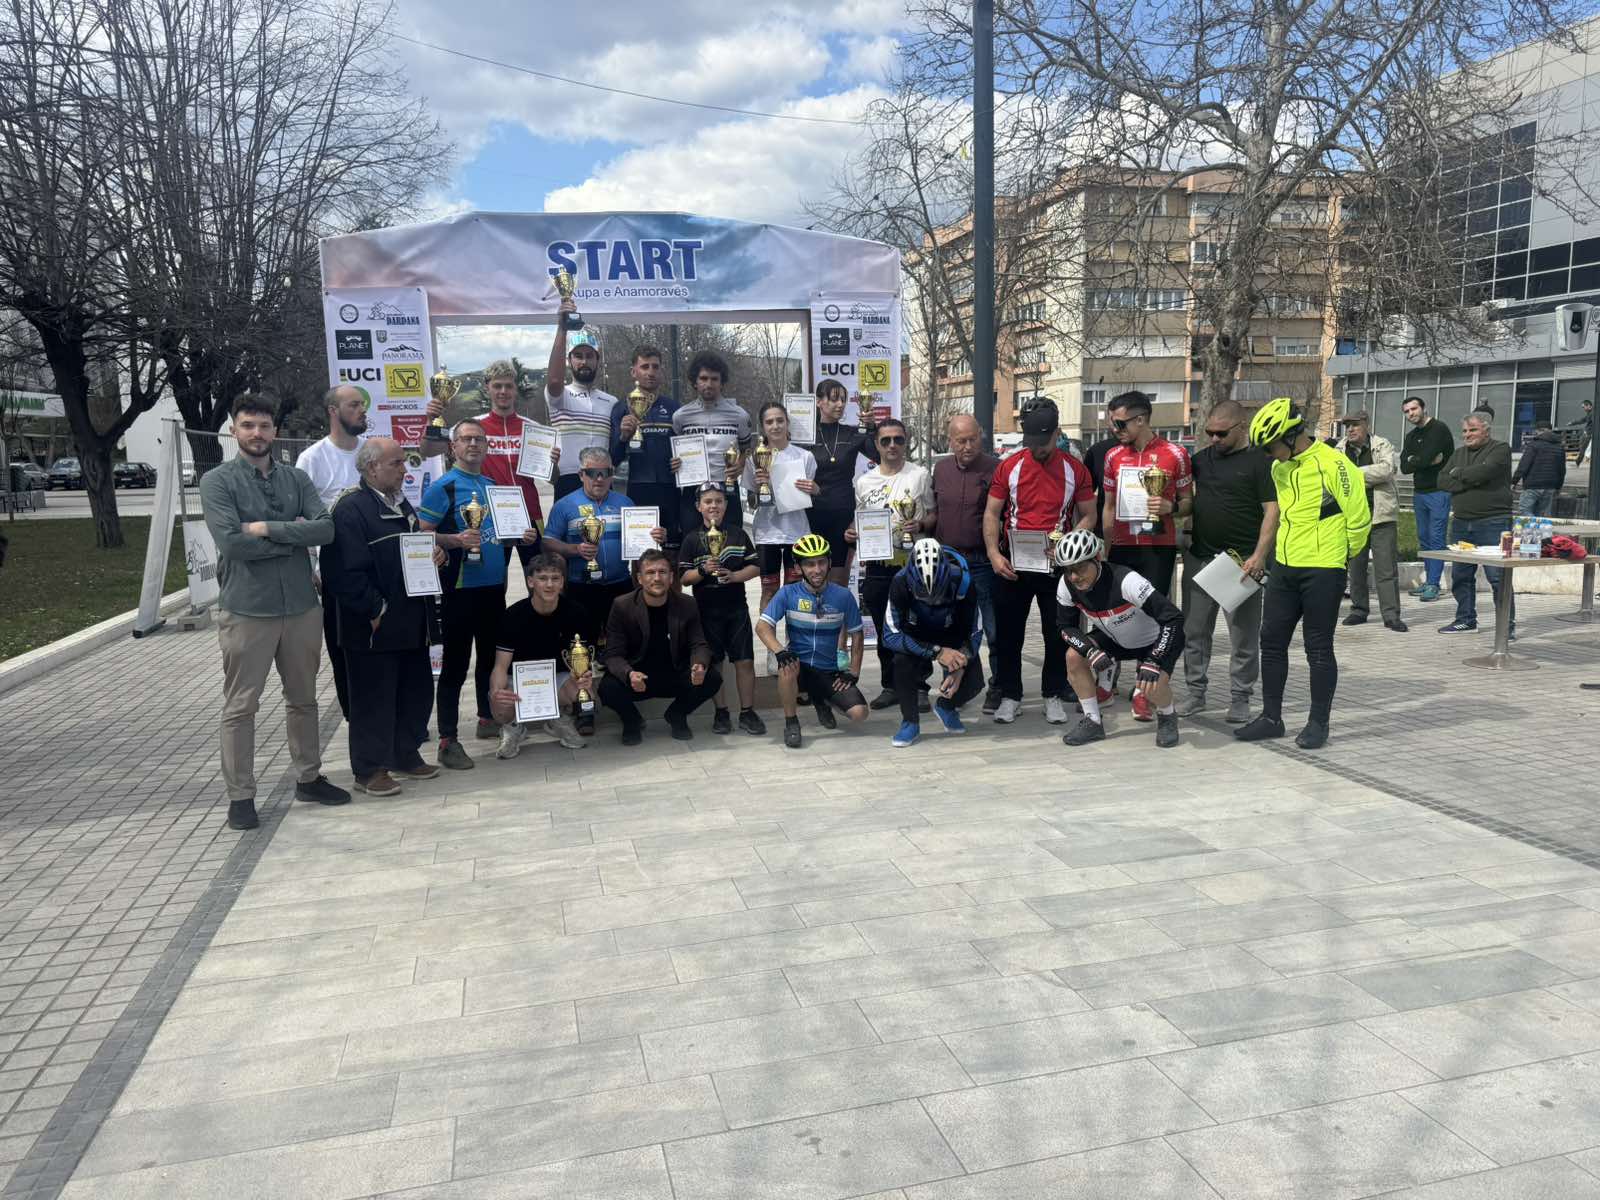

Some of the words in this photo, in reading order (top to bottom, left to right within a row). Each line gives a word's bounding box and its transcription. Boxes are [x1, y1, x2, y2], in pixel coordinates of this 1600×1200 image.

[547, 240, 702, 281] START
[603, 287, 611, 298] e
[339, 342, 369, 350] PLANET
[346, 367, 381, 381] UCI
[827, 363, 855, 376] UCI
